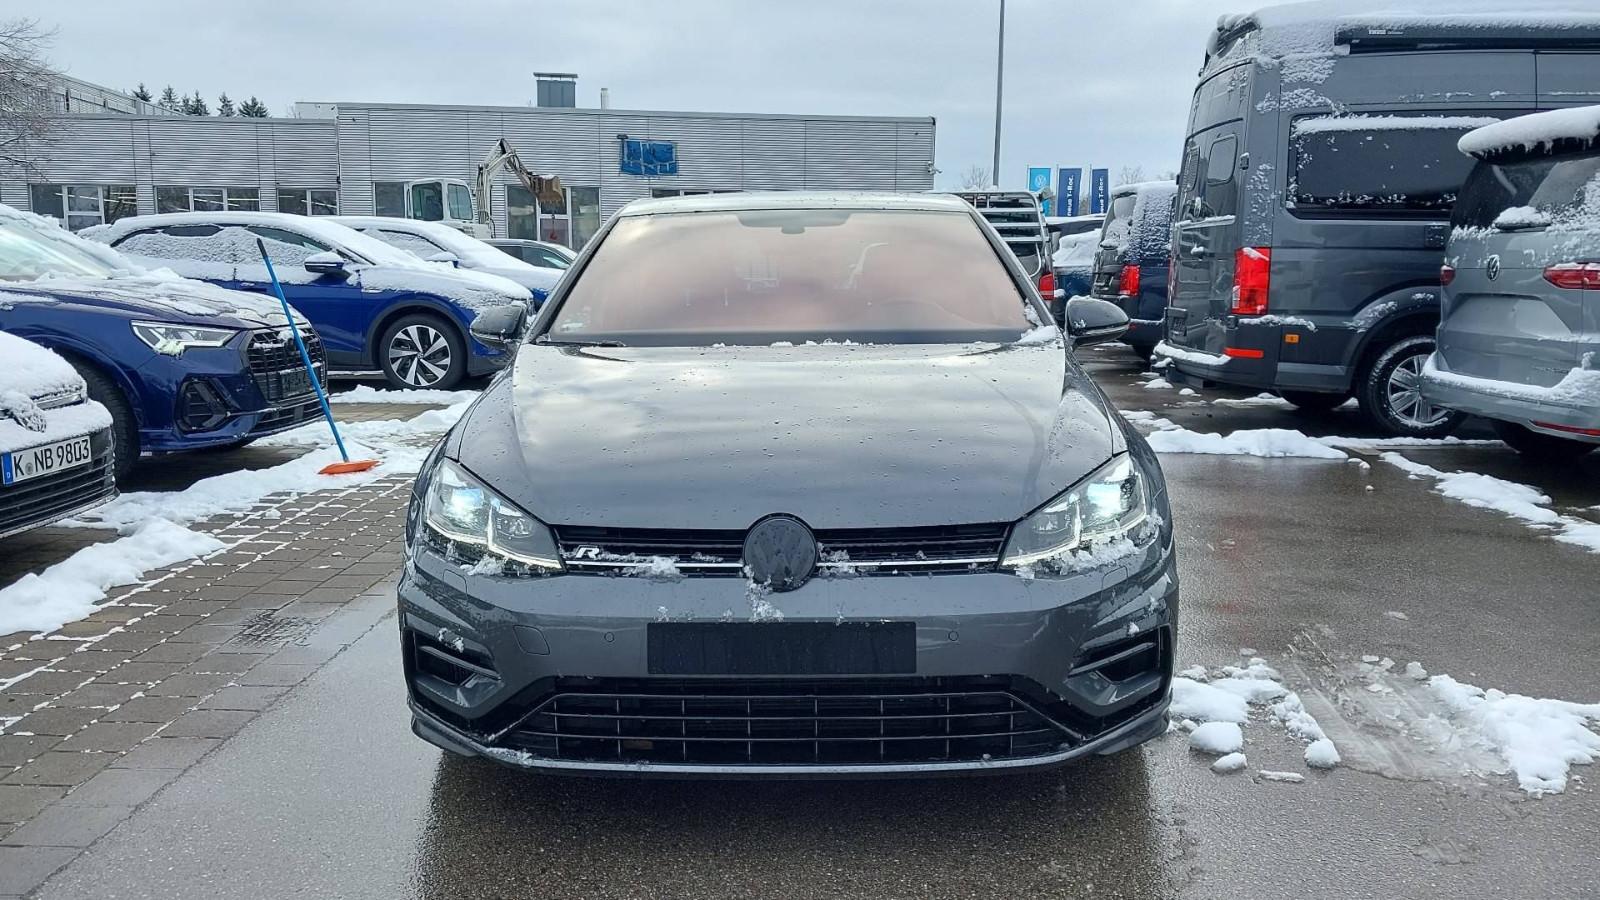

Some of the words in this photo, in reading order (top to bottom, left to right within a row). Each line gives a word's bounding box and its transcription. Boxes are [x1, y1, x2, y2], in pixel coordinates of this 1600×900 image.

[14, 455, 24, 477] K
[34, 448, 54, 472] NB
[56, 439, 89, 467] 9803
[575, 547, 600, 559] R
